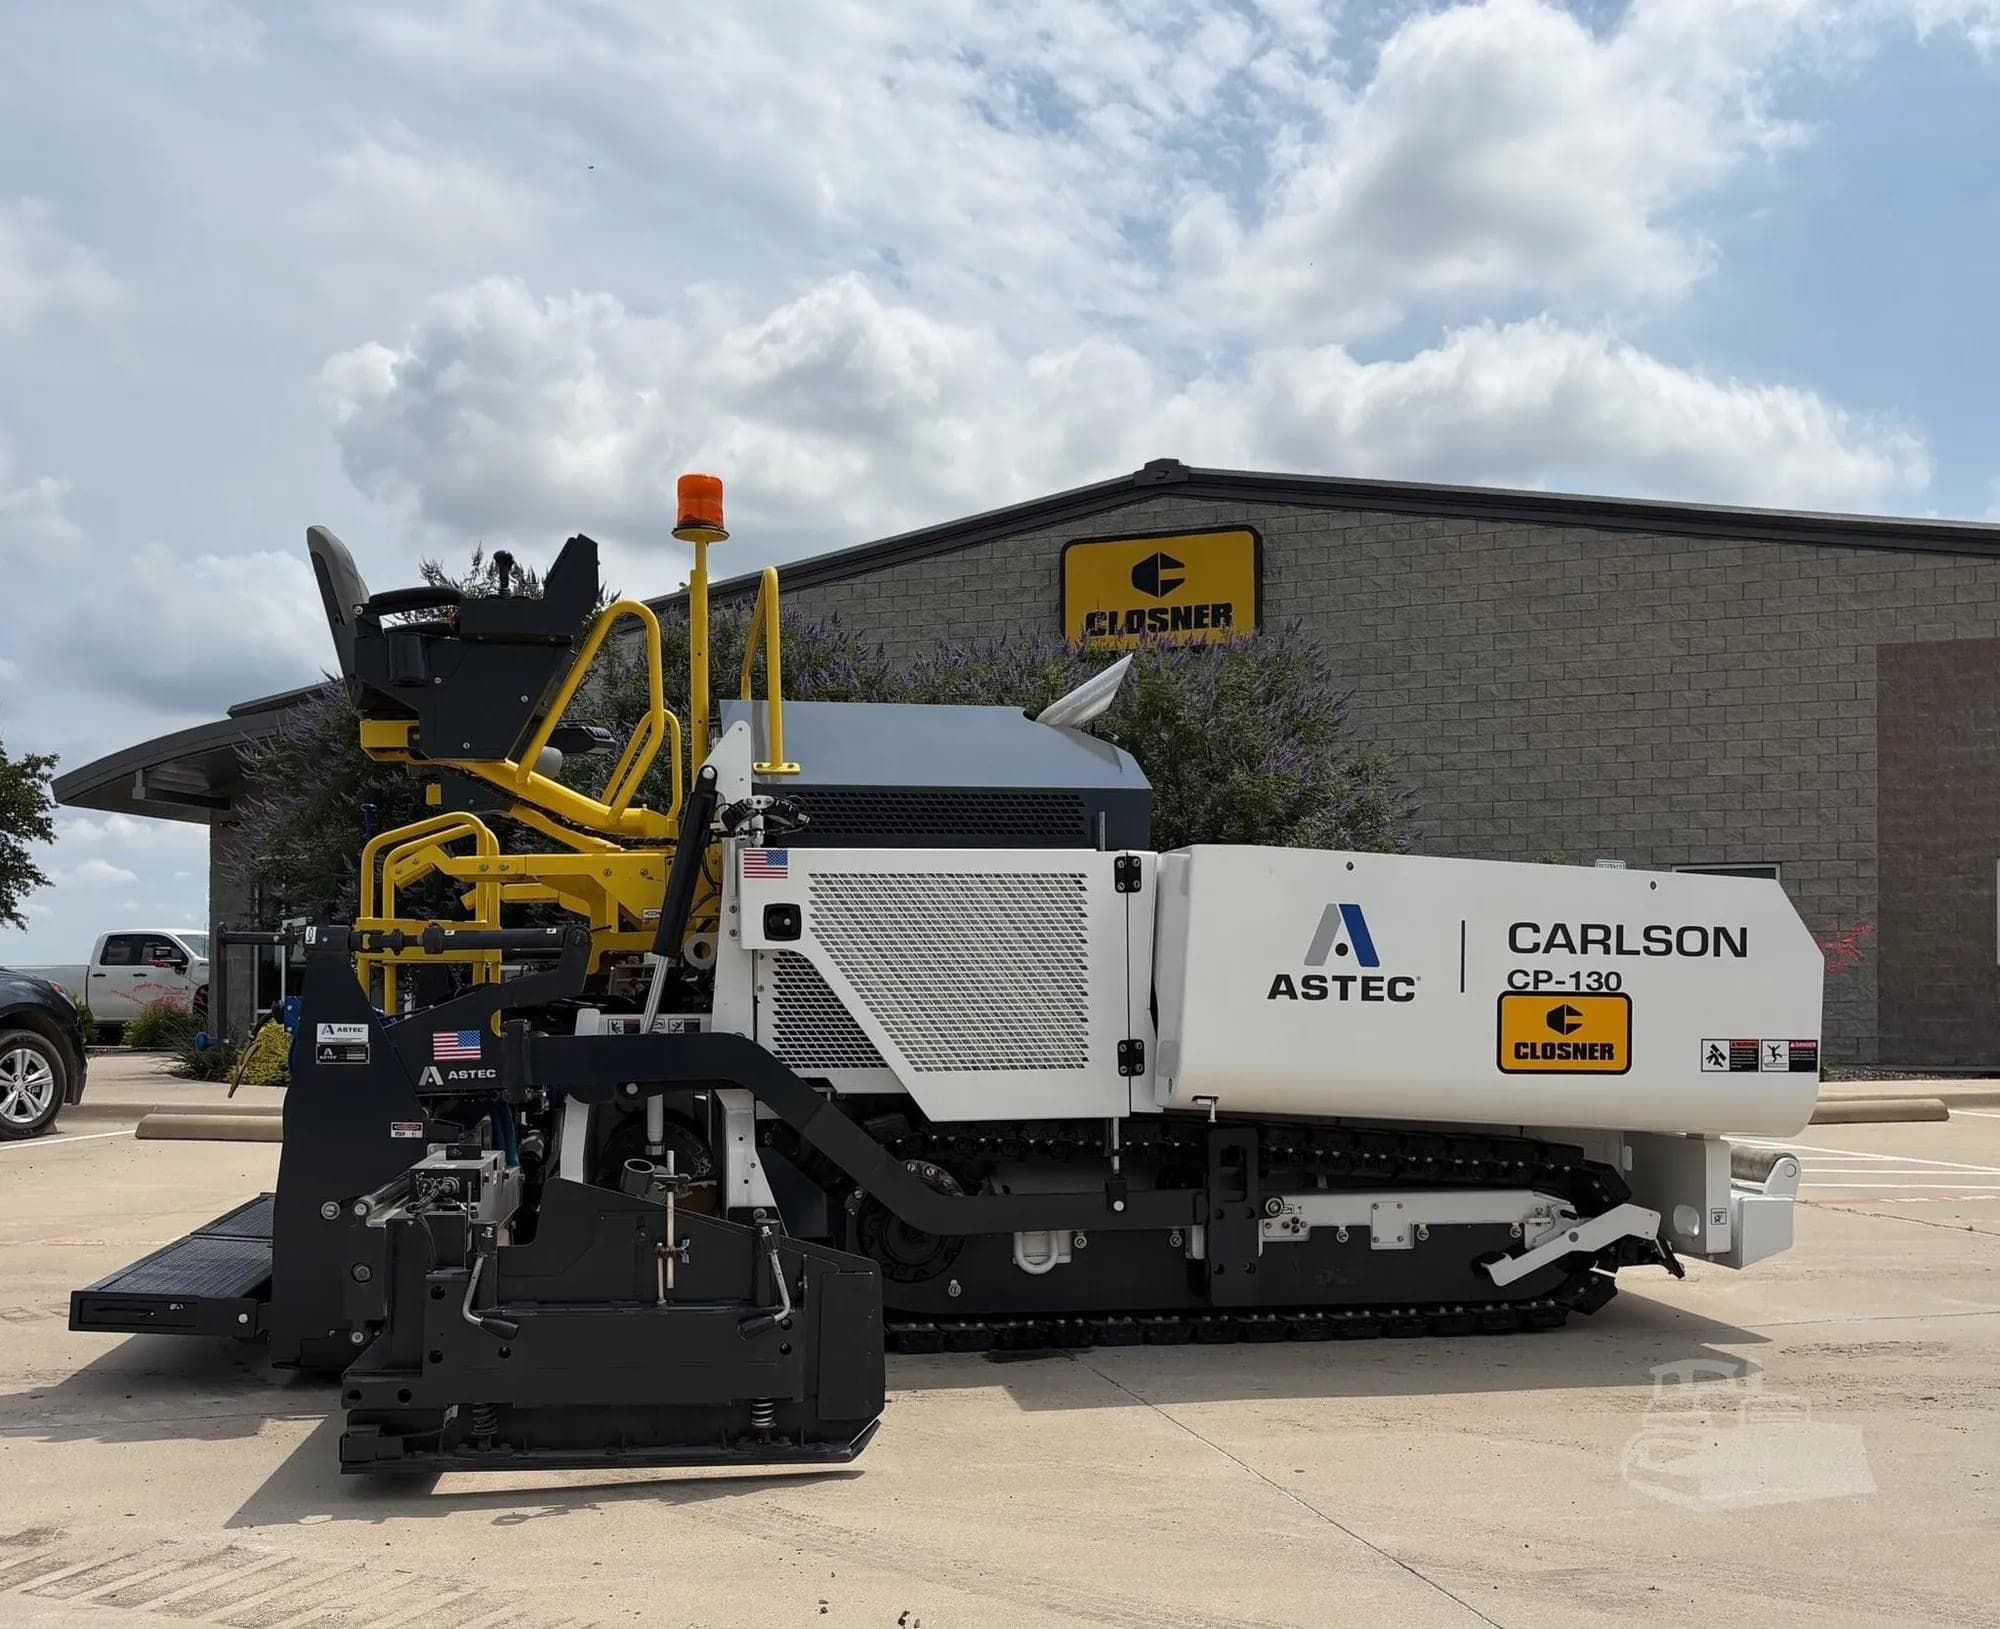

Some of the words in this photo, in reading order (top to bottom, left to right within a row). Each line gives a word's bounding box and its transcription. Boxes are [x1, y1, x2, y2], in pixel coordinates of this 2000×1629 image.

[1086, 602, 1233, 637] CLOSNER
[1507, 922, 1748, 958] CARLSON
[1267, 974, 1416, 1002] ASTEC
[1506, 969, 1623, 992] CP-130
[1513, 1042, 1615, 1062] CLOSNER
[447, 1068, 497, 1080] ASTEC
